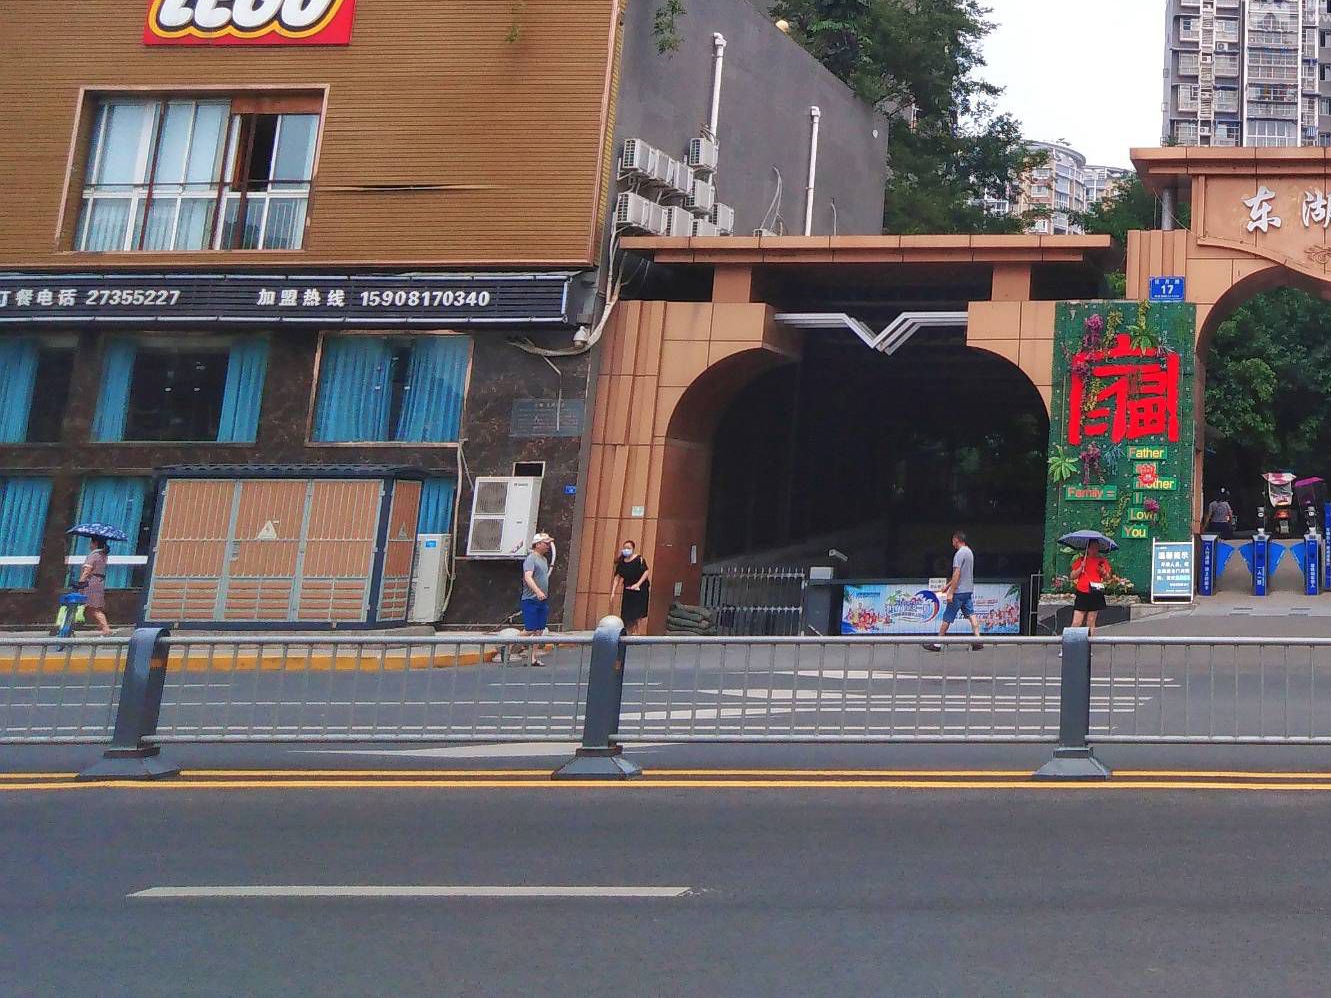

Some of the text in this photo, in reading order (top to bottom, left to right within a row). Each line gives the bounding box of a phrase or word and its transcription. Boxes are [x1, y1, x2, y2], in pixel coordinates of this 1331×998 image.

[1161, 284, 1174, 295] 17
[85, 289, 181, 306] 27355227
[257, 288, 346, 307] 加盟热线
[360, 291, 490, 307] 15908170340
[1129, 447, 1165, 459] Father
[1067, 487, 1104, 500] Family
[1122, 526, 1146, 538] You
